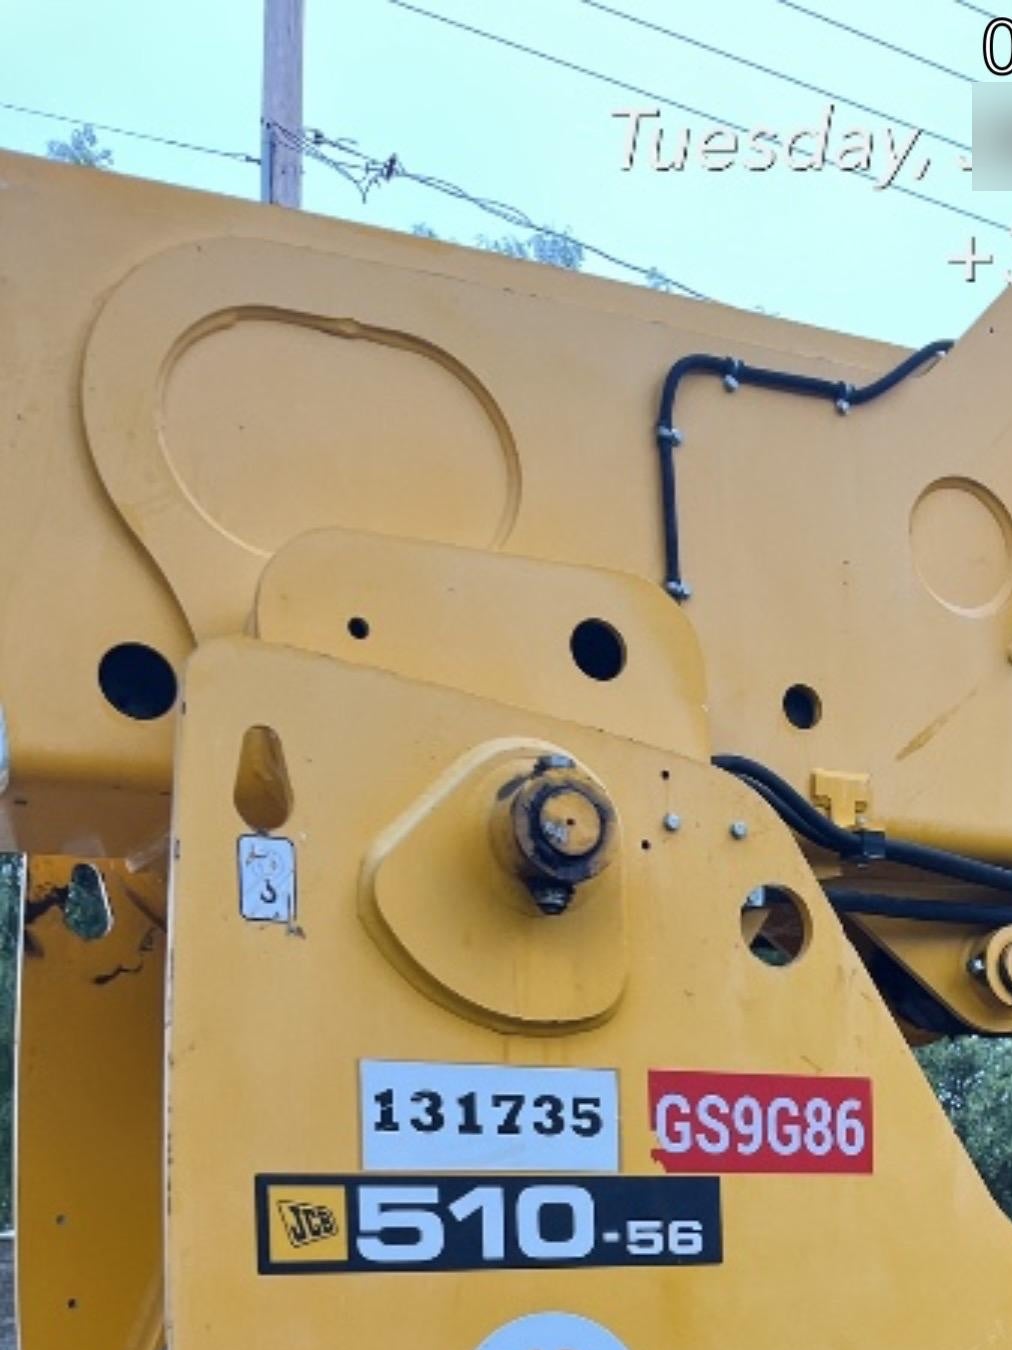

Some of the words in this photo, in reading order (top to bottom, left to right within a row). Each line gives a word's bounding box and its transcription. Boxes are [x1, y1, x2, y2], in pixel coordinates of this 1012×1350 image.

[372, 1088, 604, 1137] 131735
[654, 1092, 866, 1157] GS9G86
[282, 1202, 337, 1245] JCB
